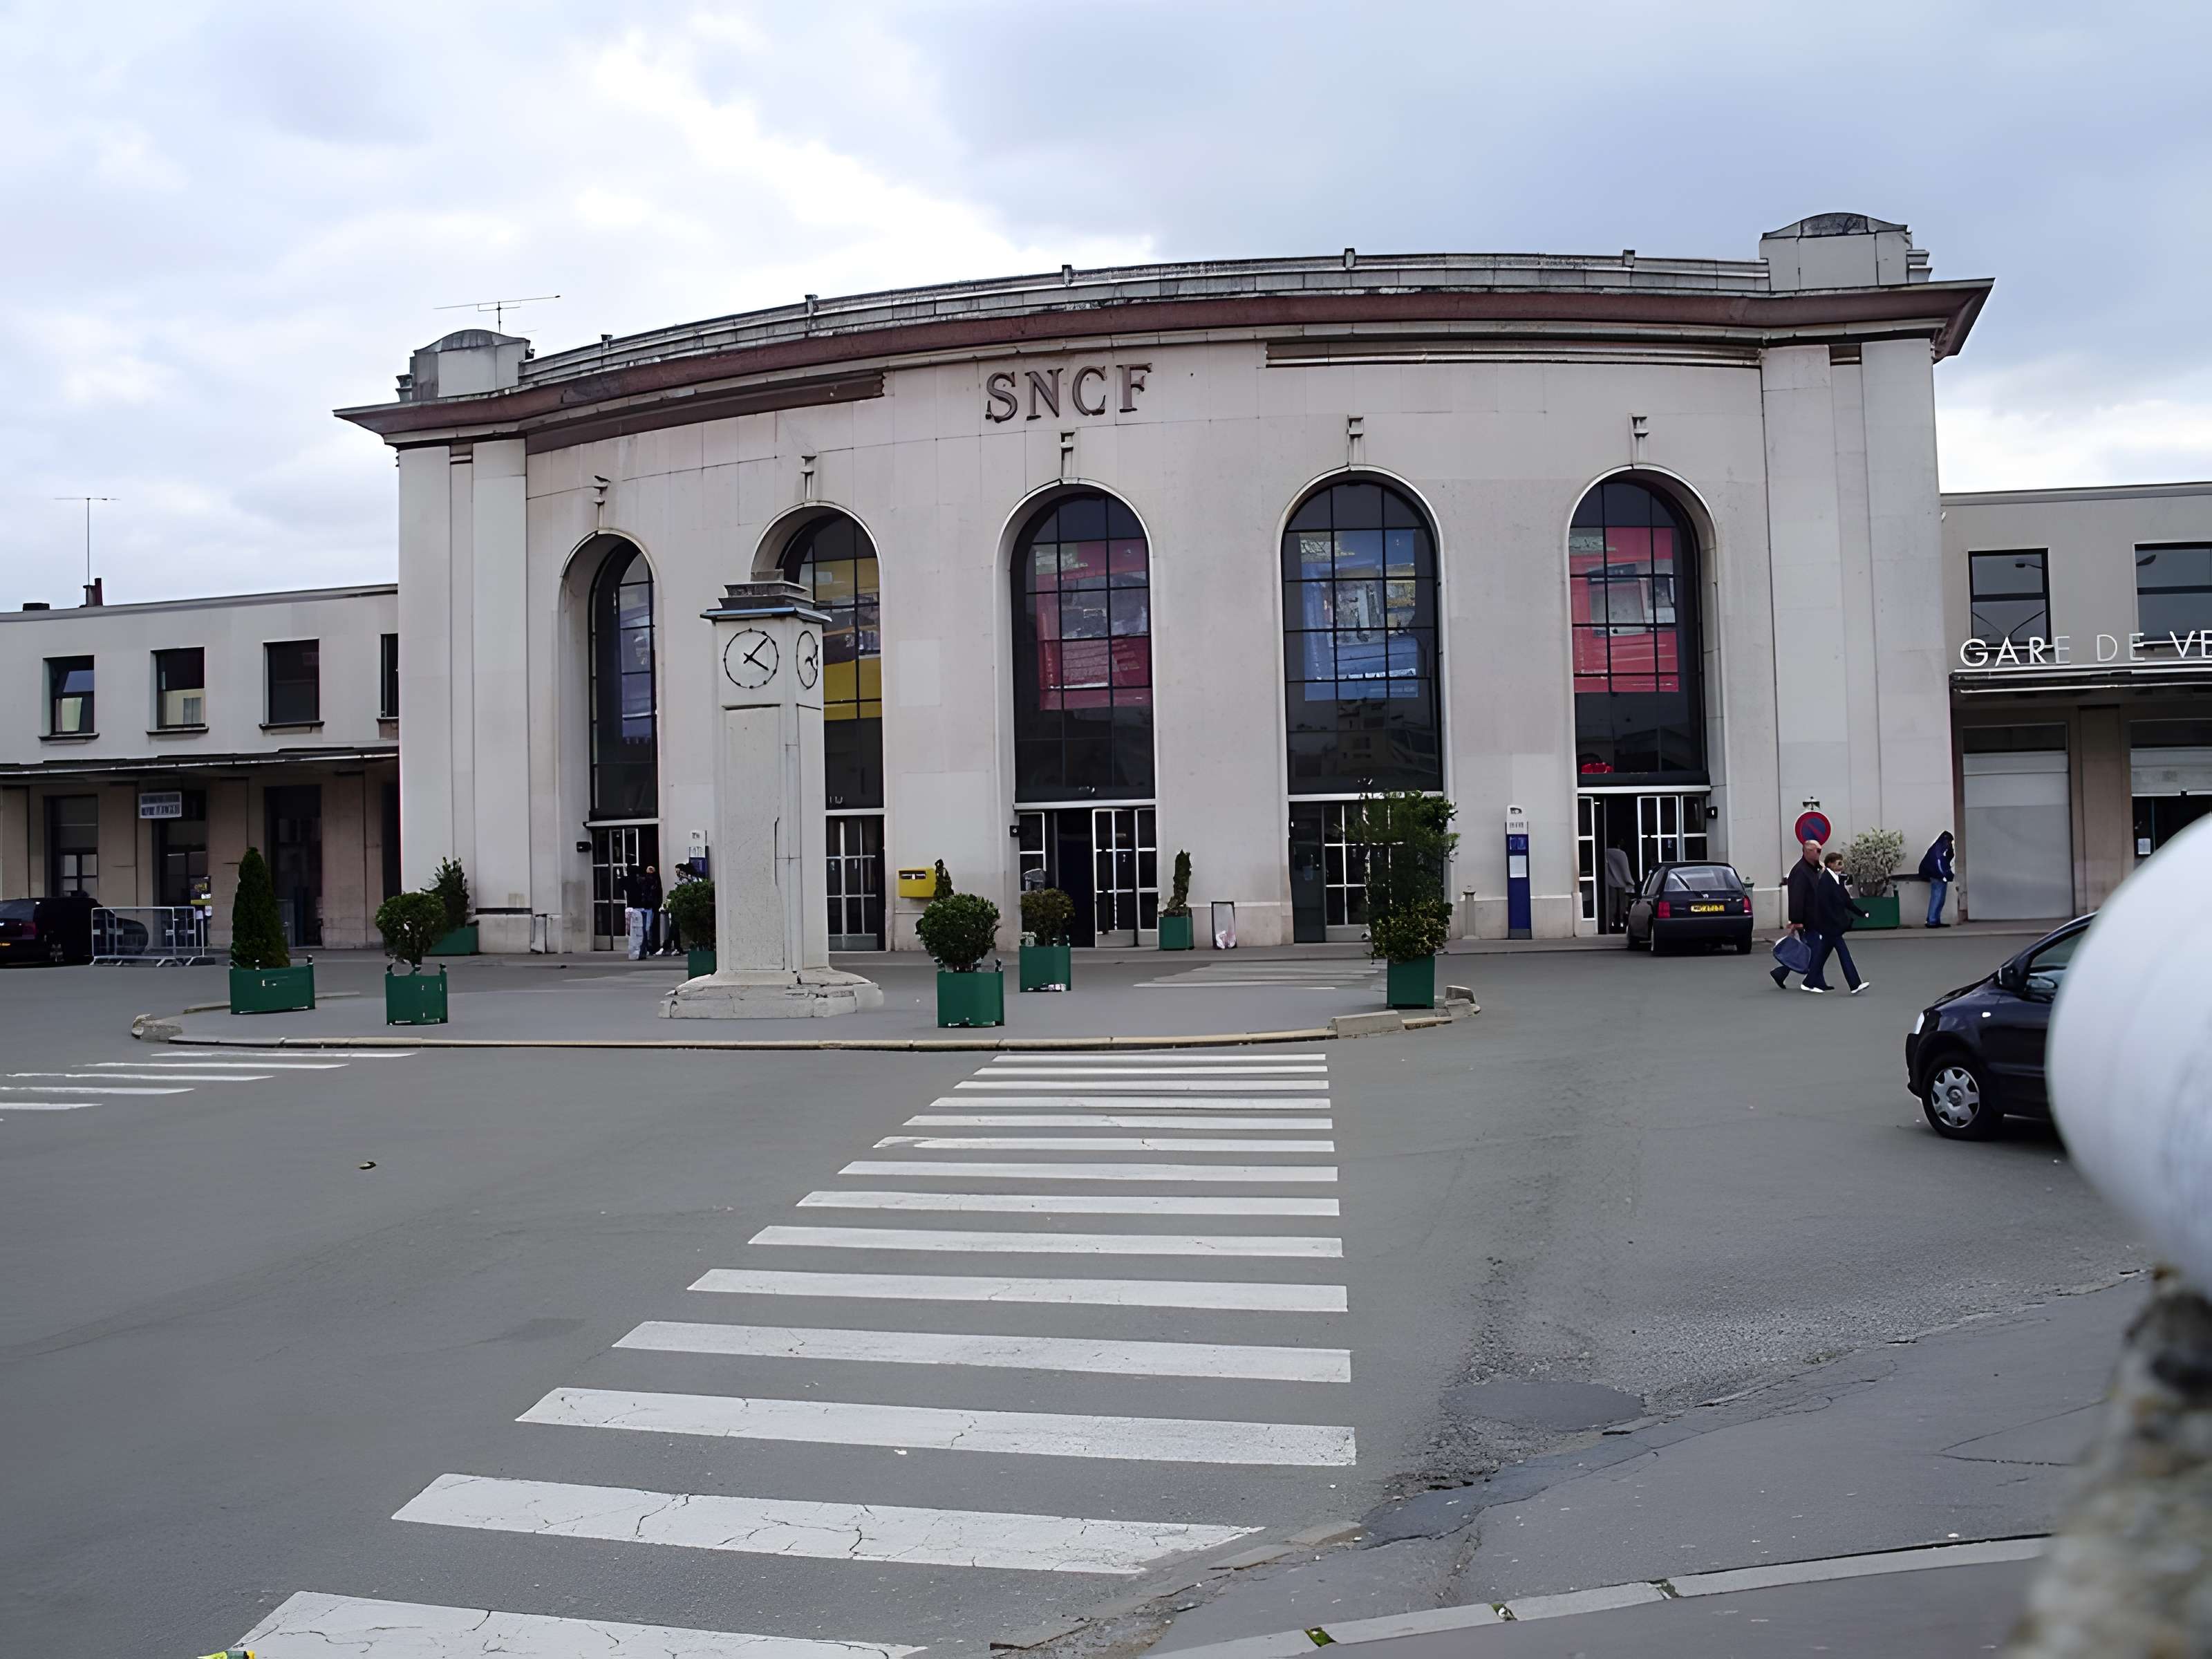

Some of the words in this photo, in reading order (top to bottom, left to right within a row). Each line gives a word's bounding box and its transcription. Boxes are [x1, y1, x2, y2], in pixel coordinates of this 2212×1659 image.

[985, 362, 1152, 424] SNCF
[1959, 635, 2071, 668] GARE
[2096, 632, 2146, 662] DE
